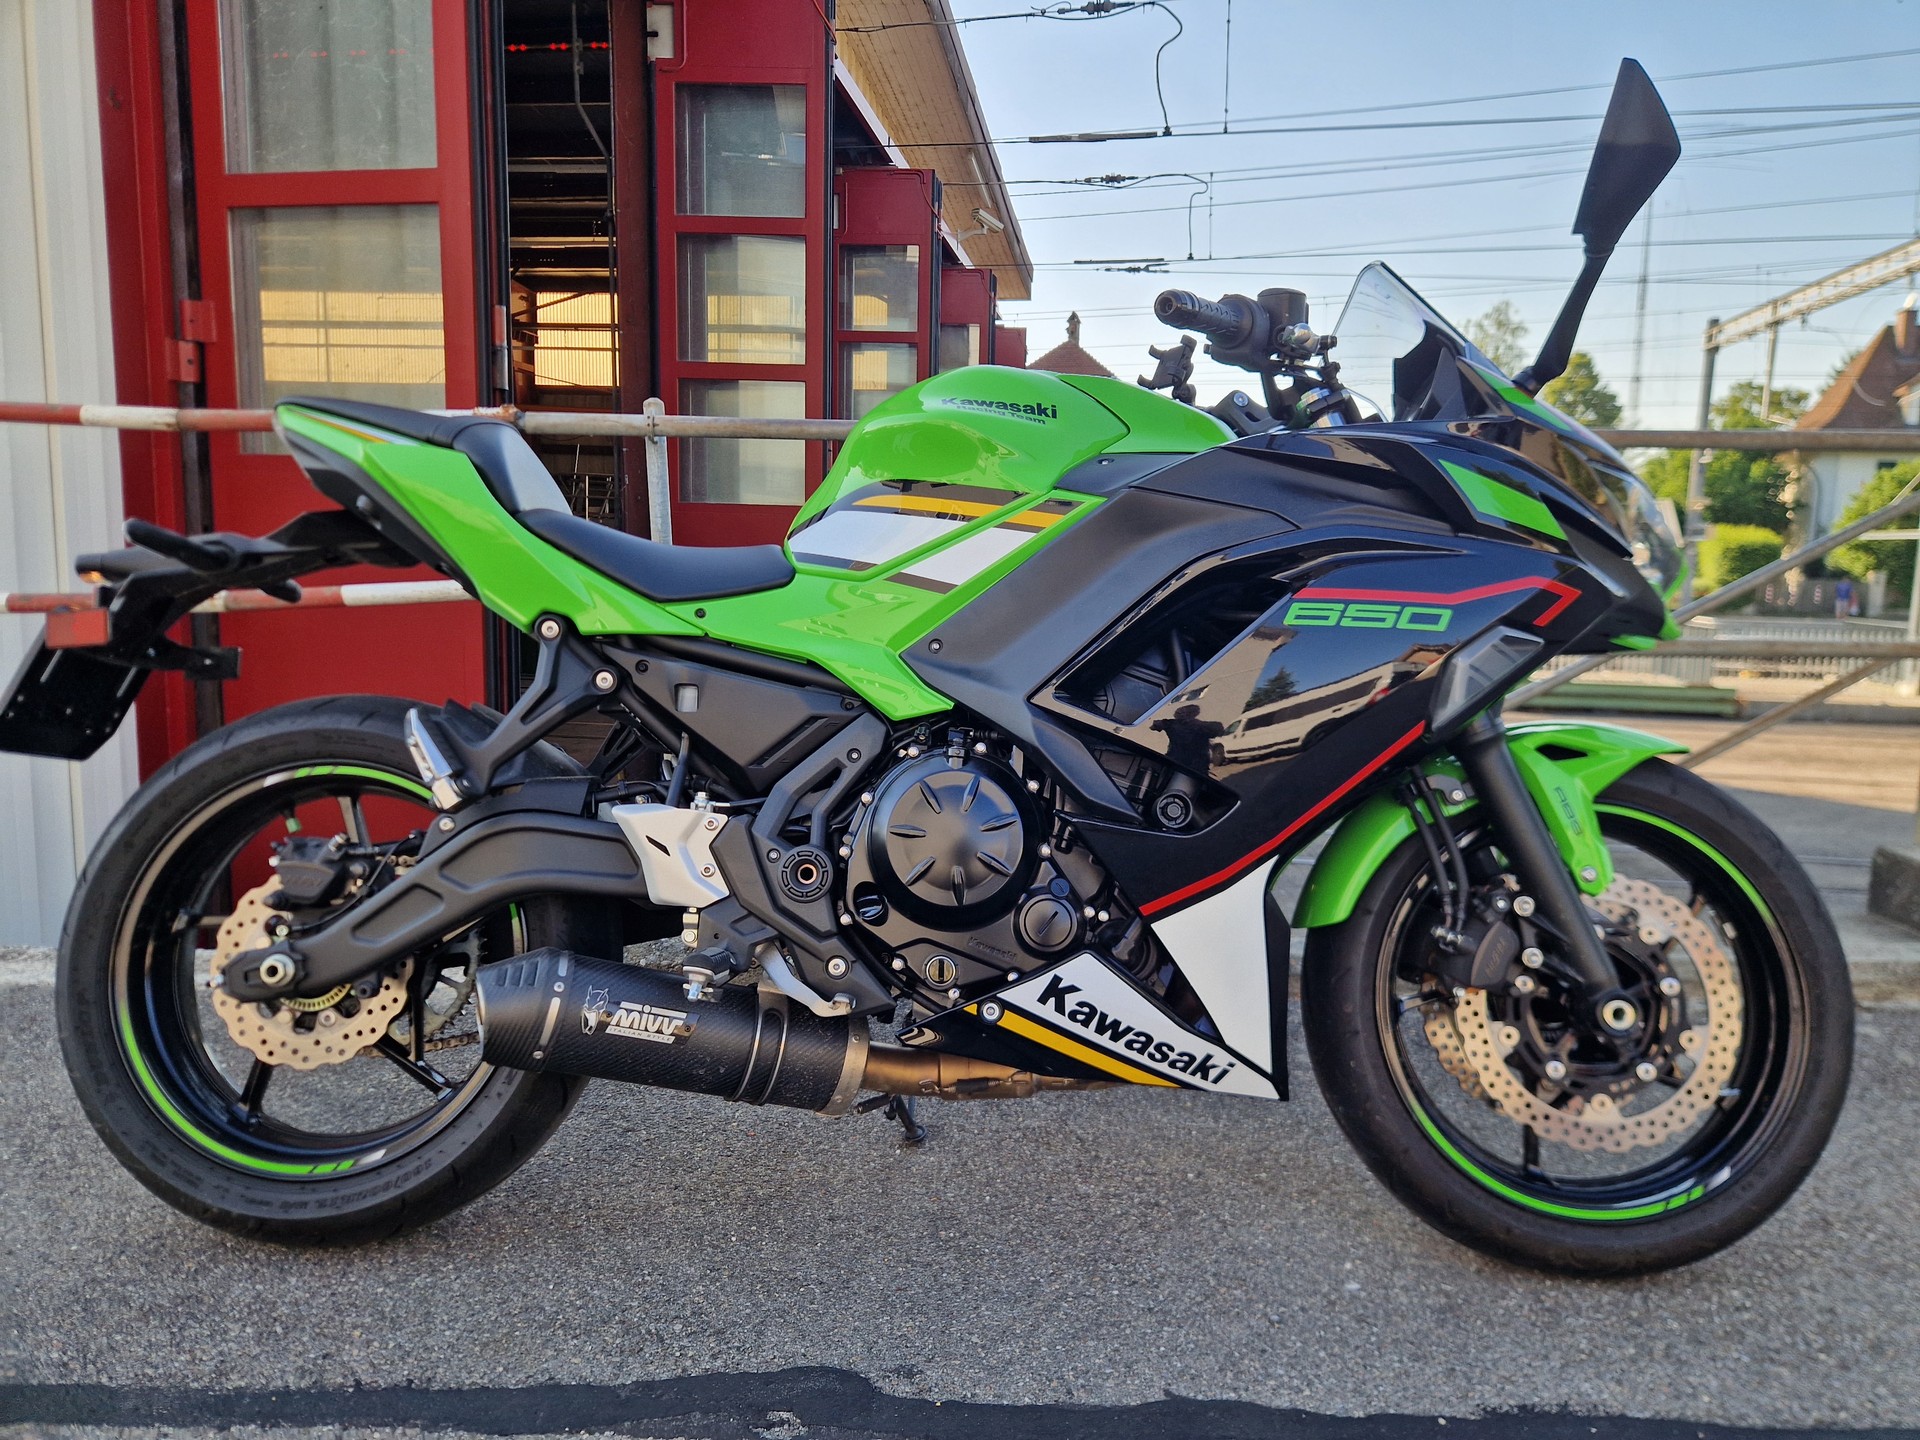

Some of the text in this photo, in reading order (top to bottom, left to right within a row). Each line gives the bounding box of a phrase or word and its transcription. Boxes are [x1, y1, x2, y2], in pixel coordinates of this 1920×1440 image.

[941, 397, 1057, 419] Kawasaki
[956, 405, 1046, 425] Racing Team
[1283, 602, 1453, 632] 650
[608, 1026, 672, 1042] ITALIAN STYLE
[1036, 973, 1236, 1085] Kawasaki
